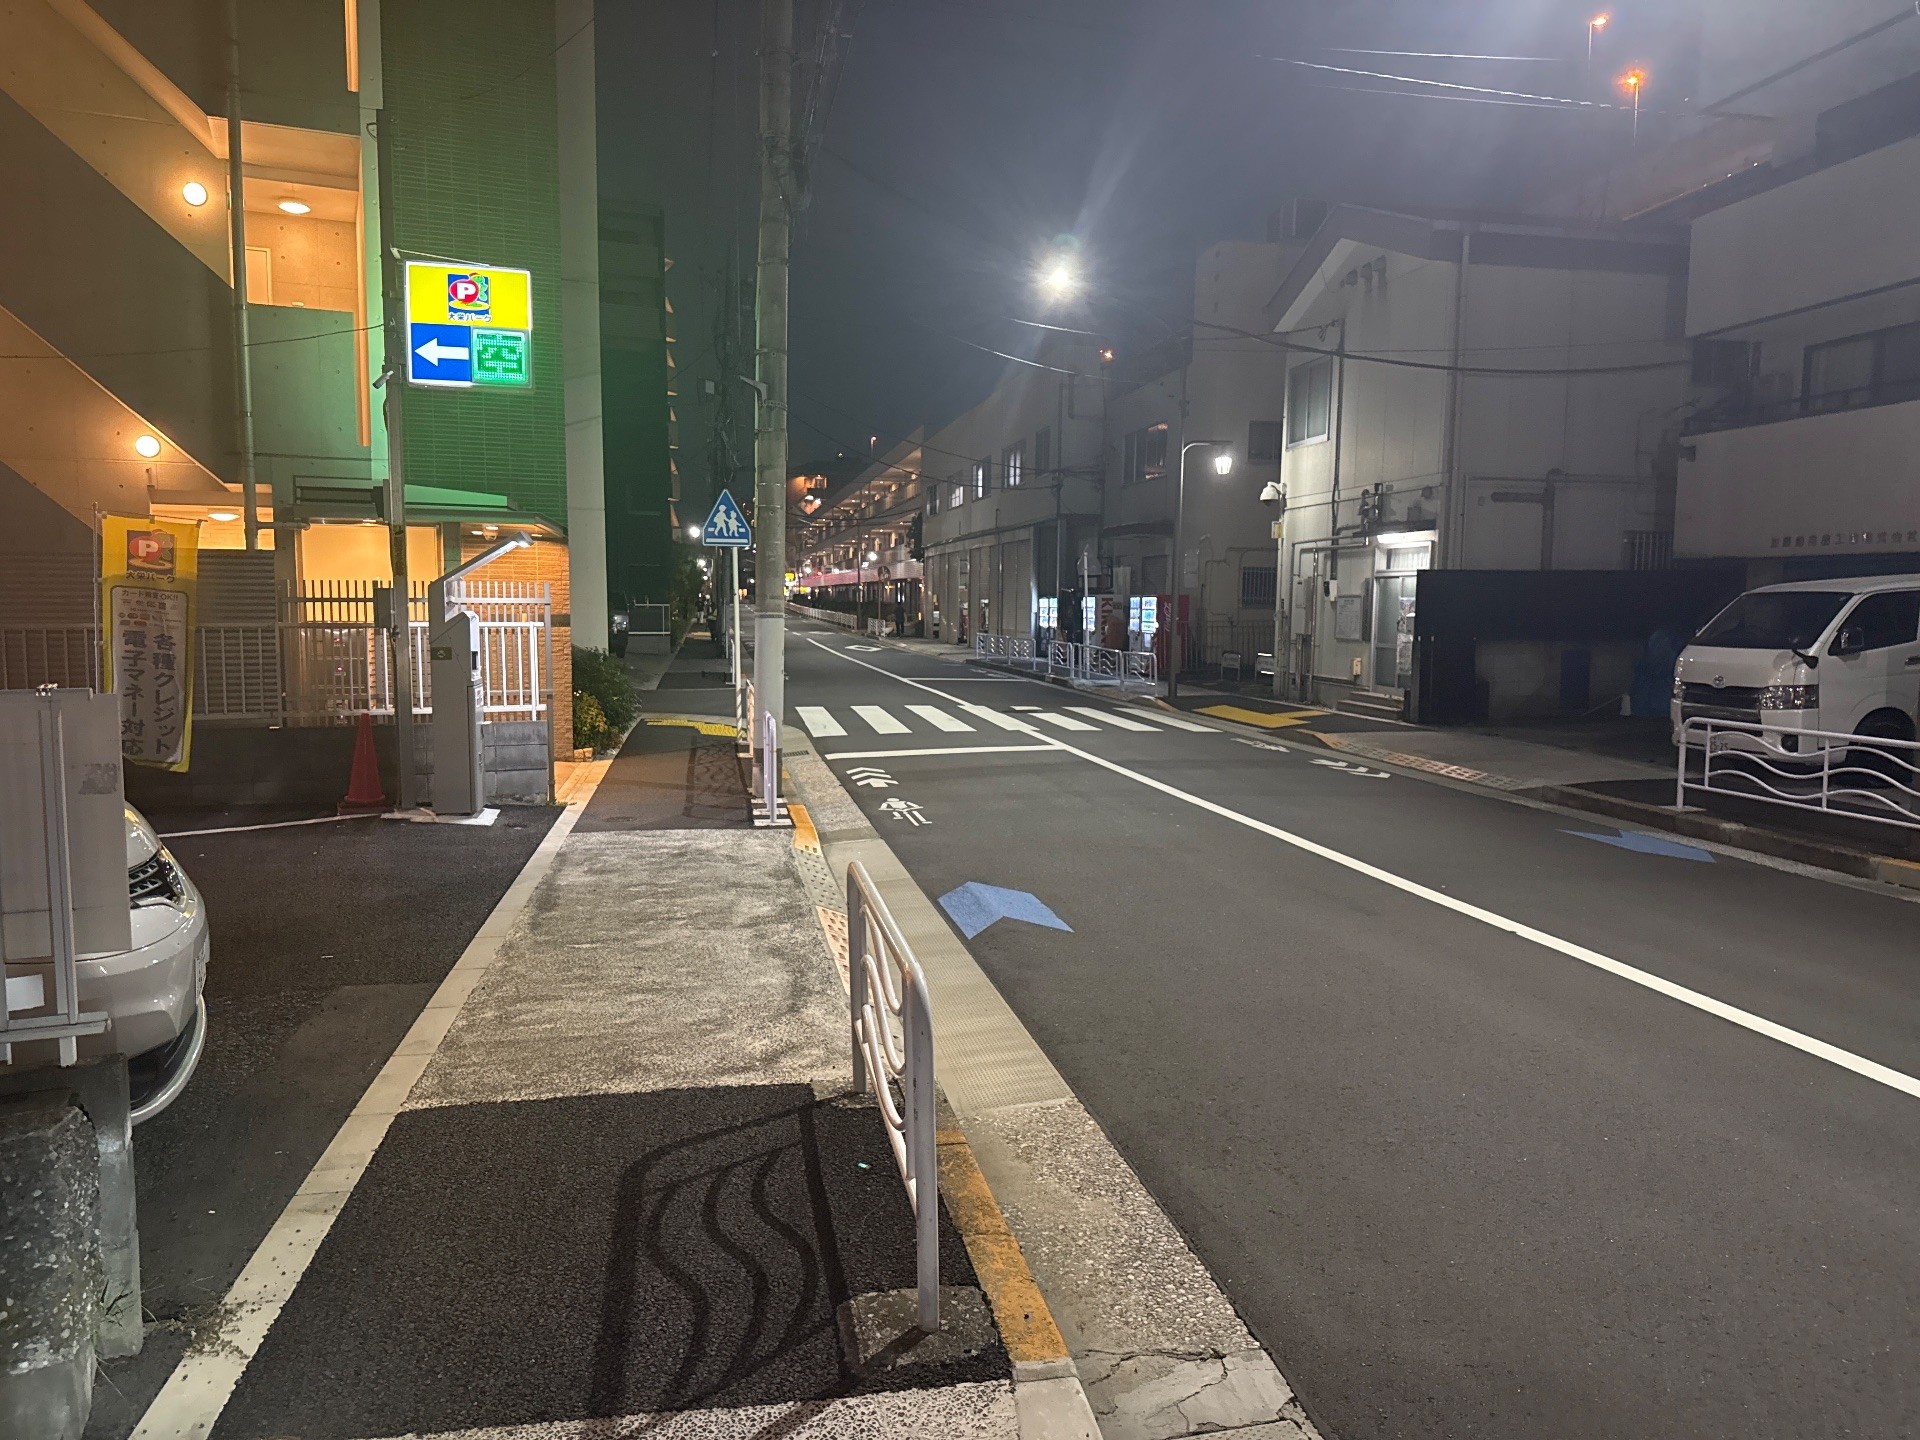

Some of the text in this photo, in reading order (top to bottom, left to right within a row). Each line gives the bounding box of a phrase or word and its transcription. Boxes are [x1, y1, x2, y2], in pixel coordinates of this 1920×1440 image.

[456, 282, 477, 300] P
[448, 313, 492, 323] 大栄パーク
[477, 333, 523, 380] 空
[138, 539, 159, 557] P
[126, 571, 175, 583] 大栄パーク
[121, 630, 147, 755] 電子マネー対応
[153, 633, 176, 755] 各種クレジット
